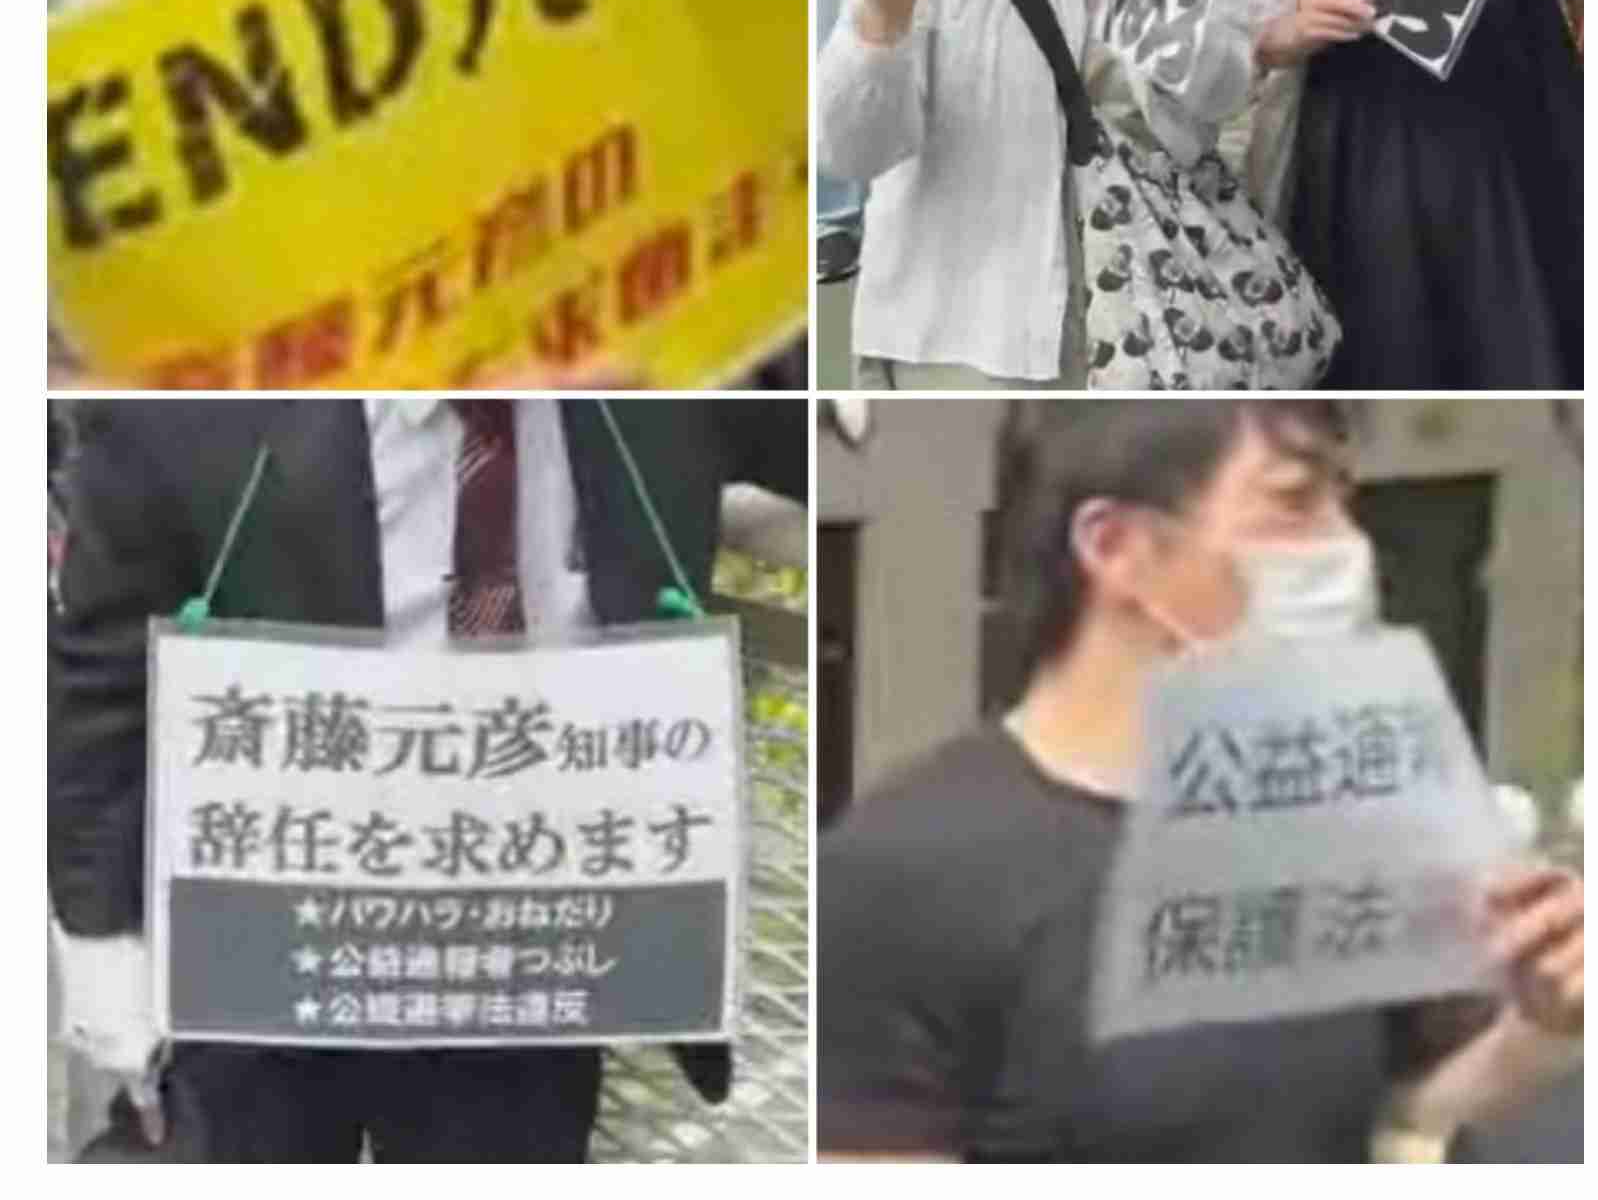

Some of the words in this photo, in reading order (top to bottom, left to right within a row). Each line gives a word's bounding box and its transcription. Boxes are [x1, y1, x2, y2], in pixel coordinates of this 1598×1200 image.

[190, 685, 712, 780] 斎藤元彦知事の
[190, 801, 714, 878] 辞任を求めます
